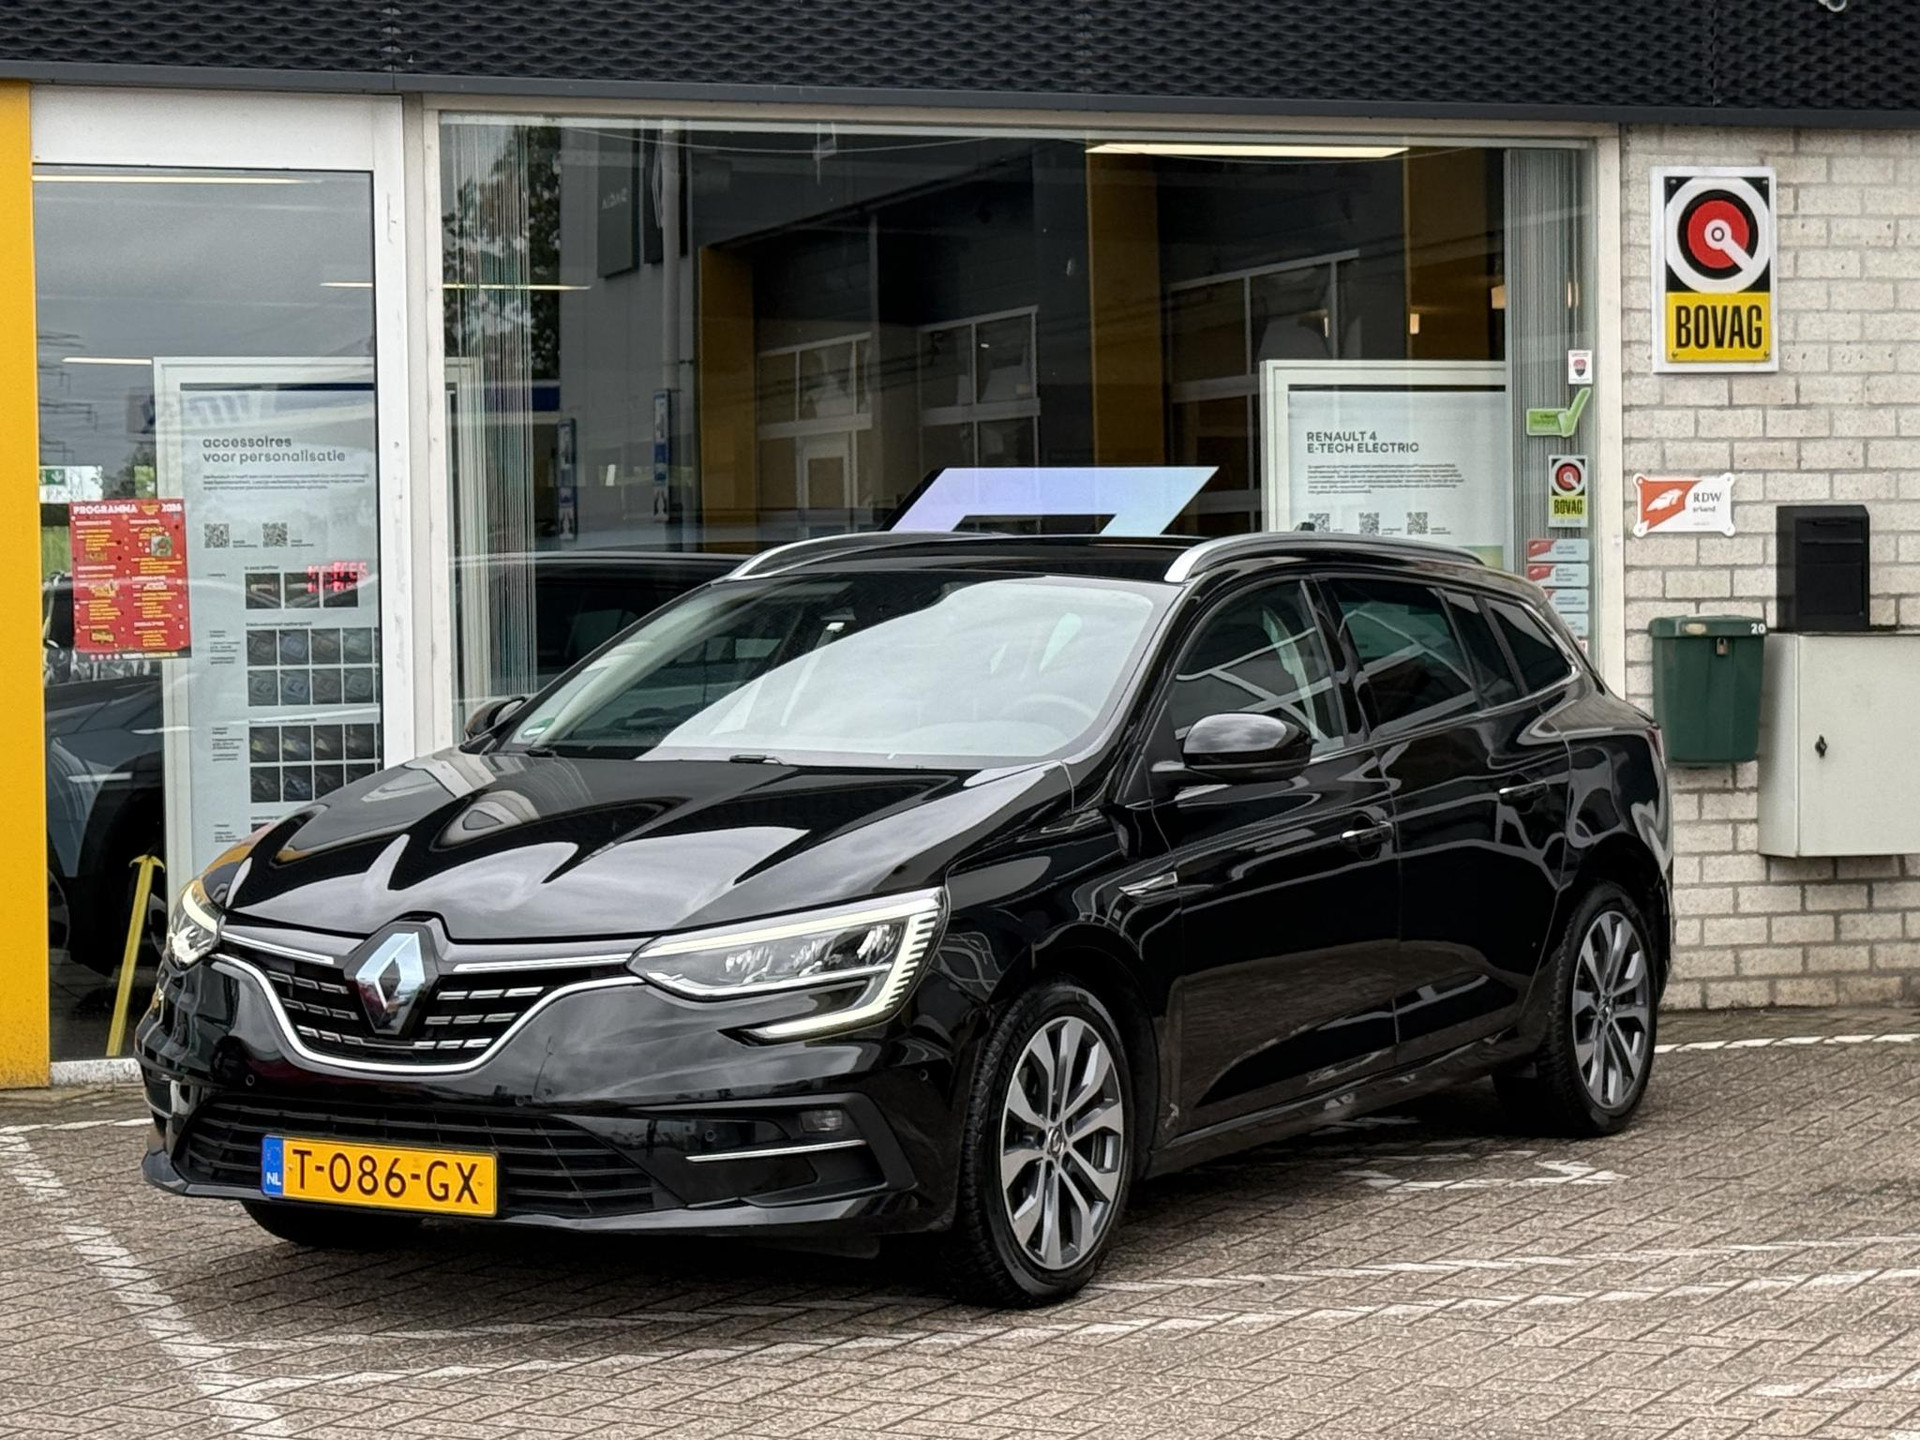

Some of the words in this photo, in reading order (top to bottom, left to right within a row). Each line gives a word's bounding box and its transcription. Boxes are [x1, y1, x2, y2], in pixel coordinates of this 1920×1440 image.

[1676, 304, 1762, 348] BOVAG
[203, 436, 292, 448] accessoires
[1307, 431, 1366, 442] RENAULT
[1369, 431, 1377, 442] 4
[1307, 443, 1354, 453] E-TECH
[1357, 443, 1419, 453] ELECTRIC
[203, 452, 235, 462] voor
[240, 450, 346, 465] personalisatie
[1693, 492, 1721, 503] RDW
[73, 504, 138, 514] PROGRAMMA
[1554, 499, 1583, 514] BOVAG
[1751, 623, 1766, 633] 20
[266, 1172, 281, 1186] NL
[292, 1149, 479, 1204] T-086-GX
